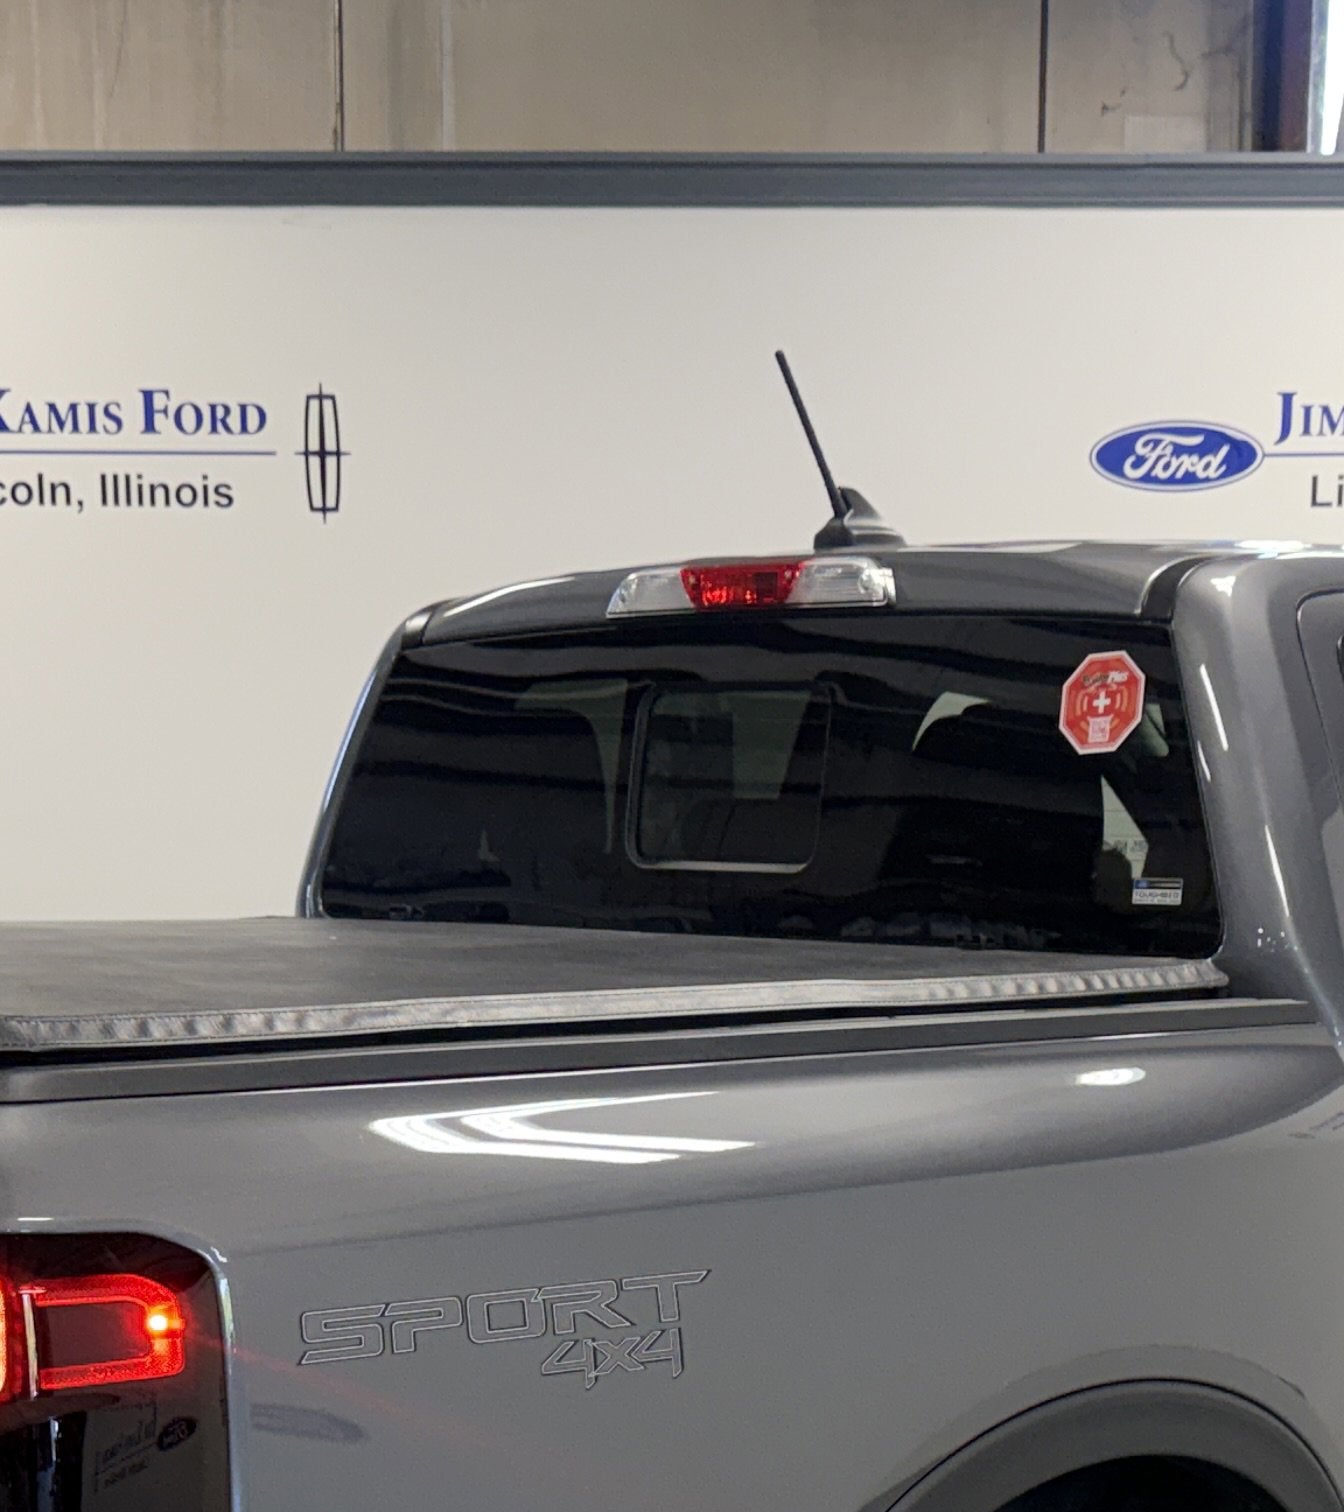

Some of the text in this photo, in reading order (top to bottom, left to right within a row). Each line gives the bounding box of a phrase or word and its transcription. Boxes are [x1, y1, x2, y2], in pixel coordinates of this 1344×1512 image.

[139, 388, 267, 435] FORD
[1122, 432, 1227, 480] Ford
[99, 473, 235, 508] Illinois
[298, 1269, 712, 1366] SPORT
